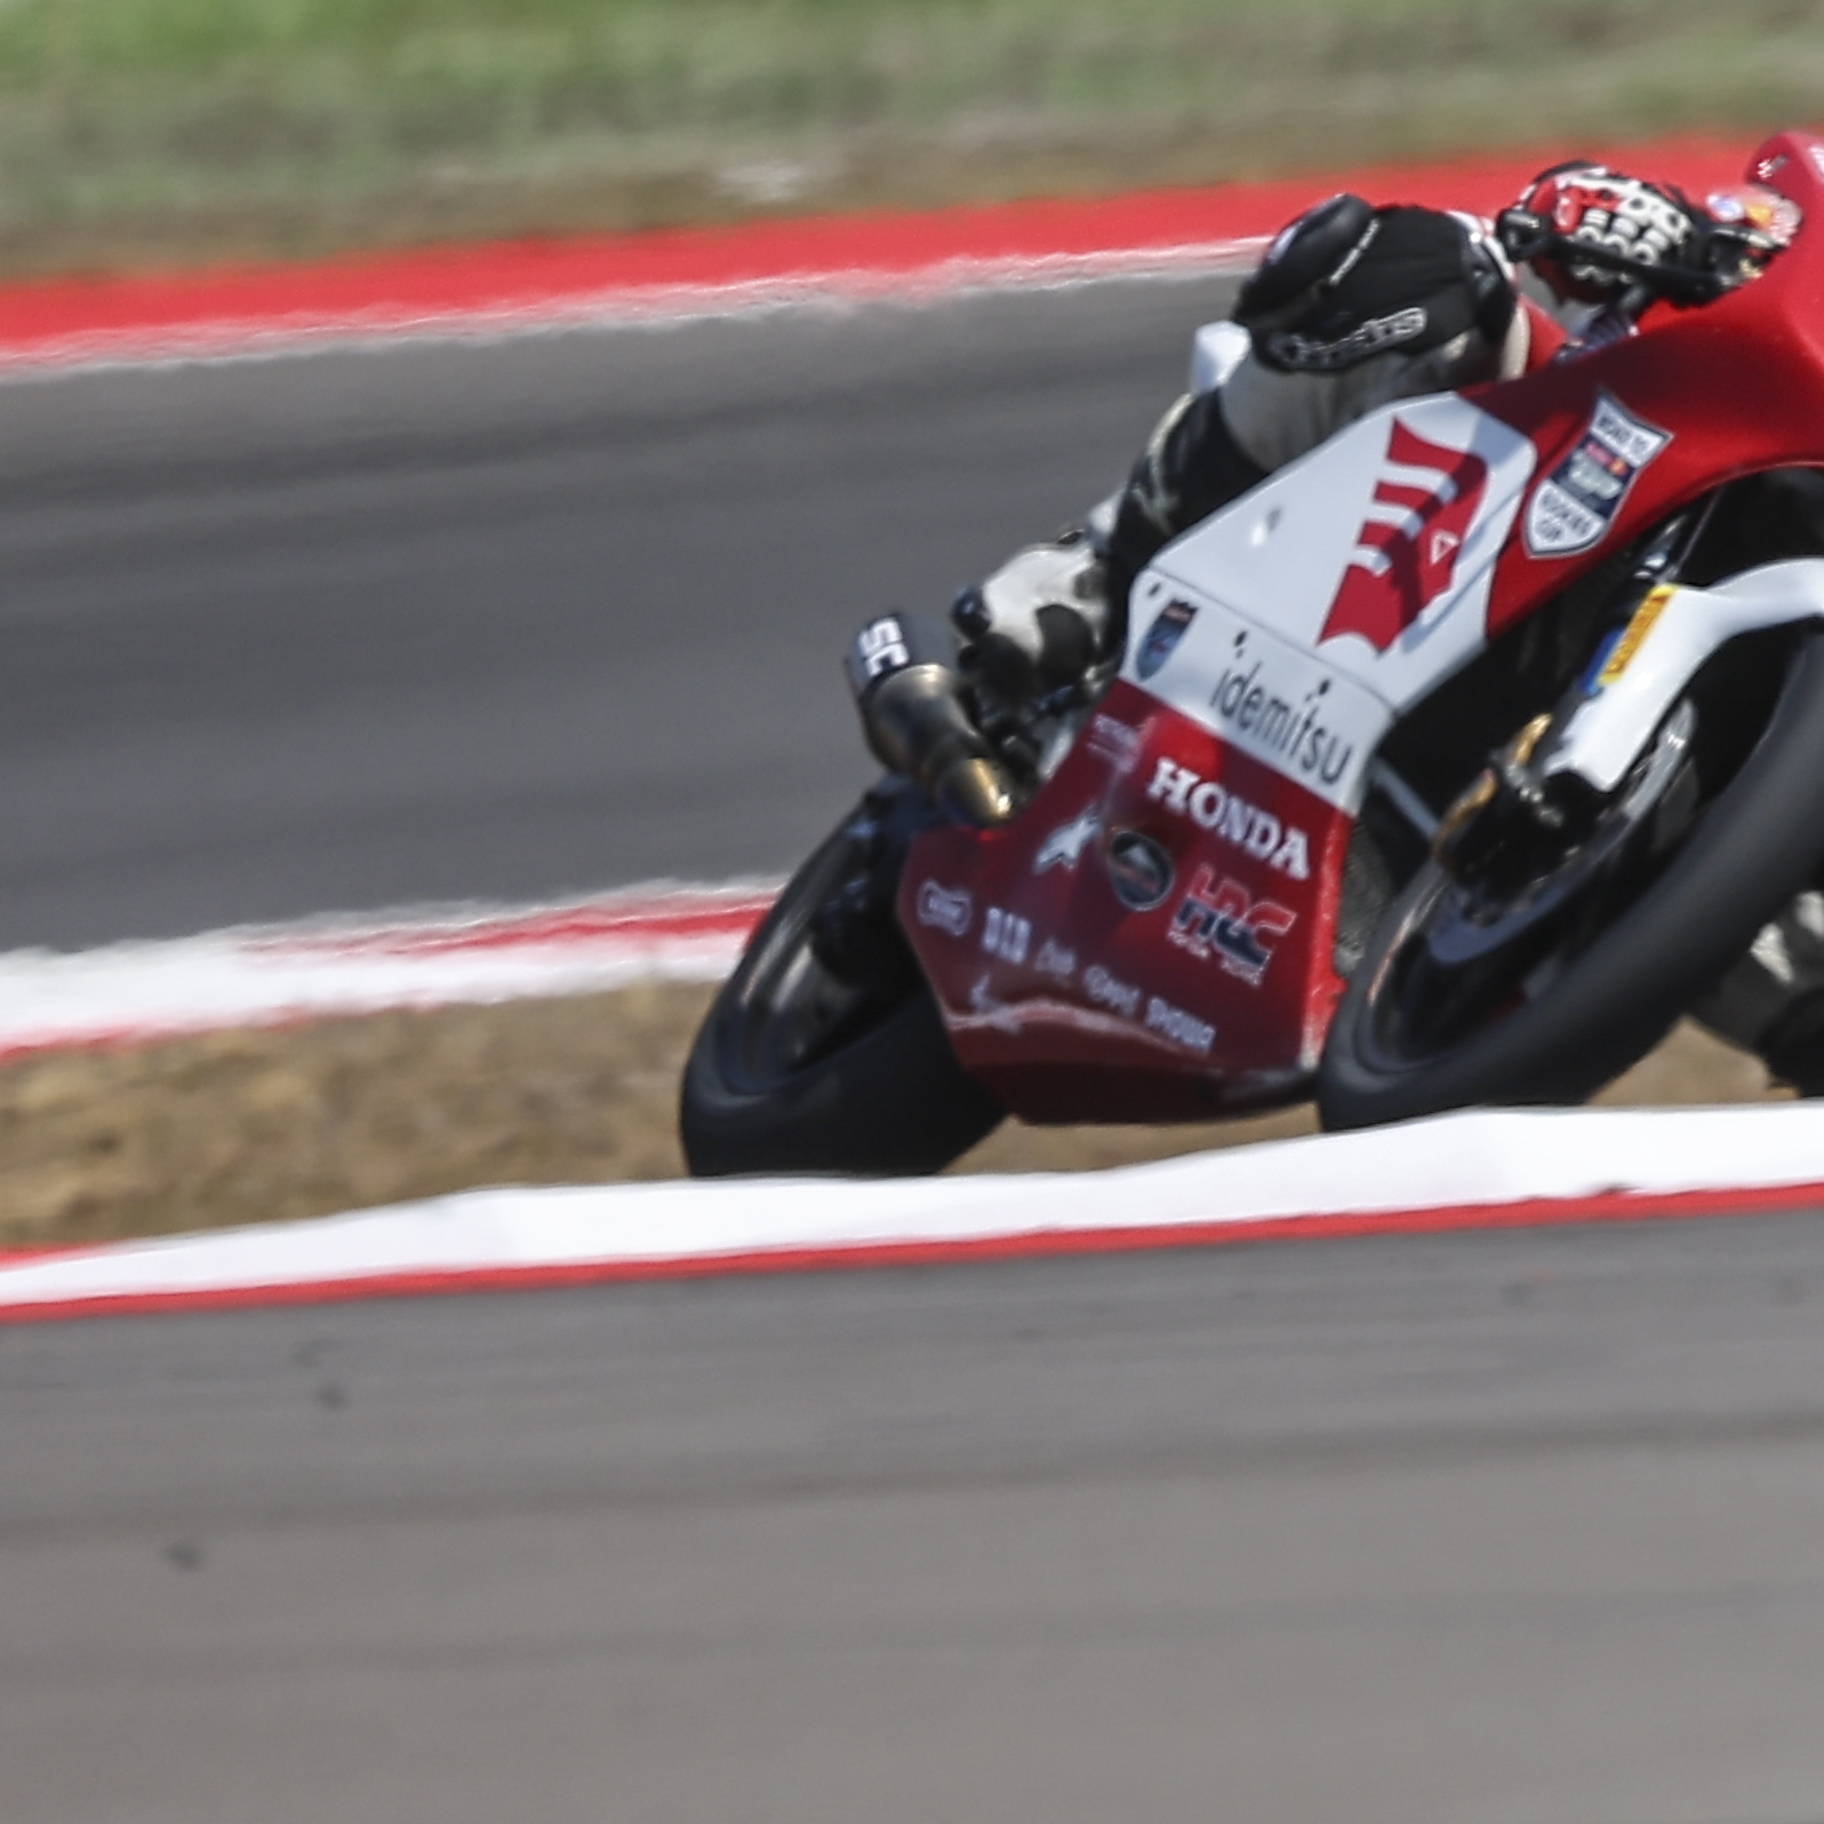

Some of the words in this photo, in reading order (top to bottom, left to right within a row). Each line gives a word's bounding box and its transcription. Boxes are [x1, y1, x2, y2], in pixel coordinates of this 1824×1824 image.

[858, 616, 909, 677] SC
[1209, 650, 1353, 787] idemitsu
[1146, 756, 1312, 880] HONDA
[1168, 862, 1298, 972] HRC
